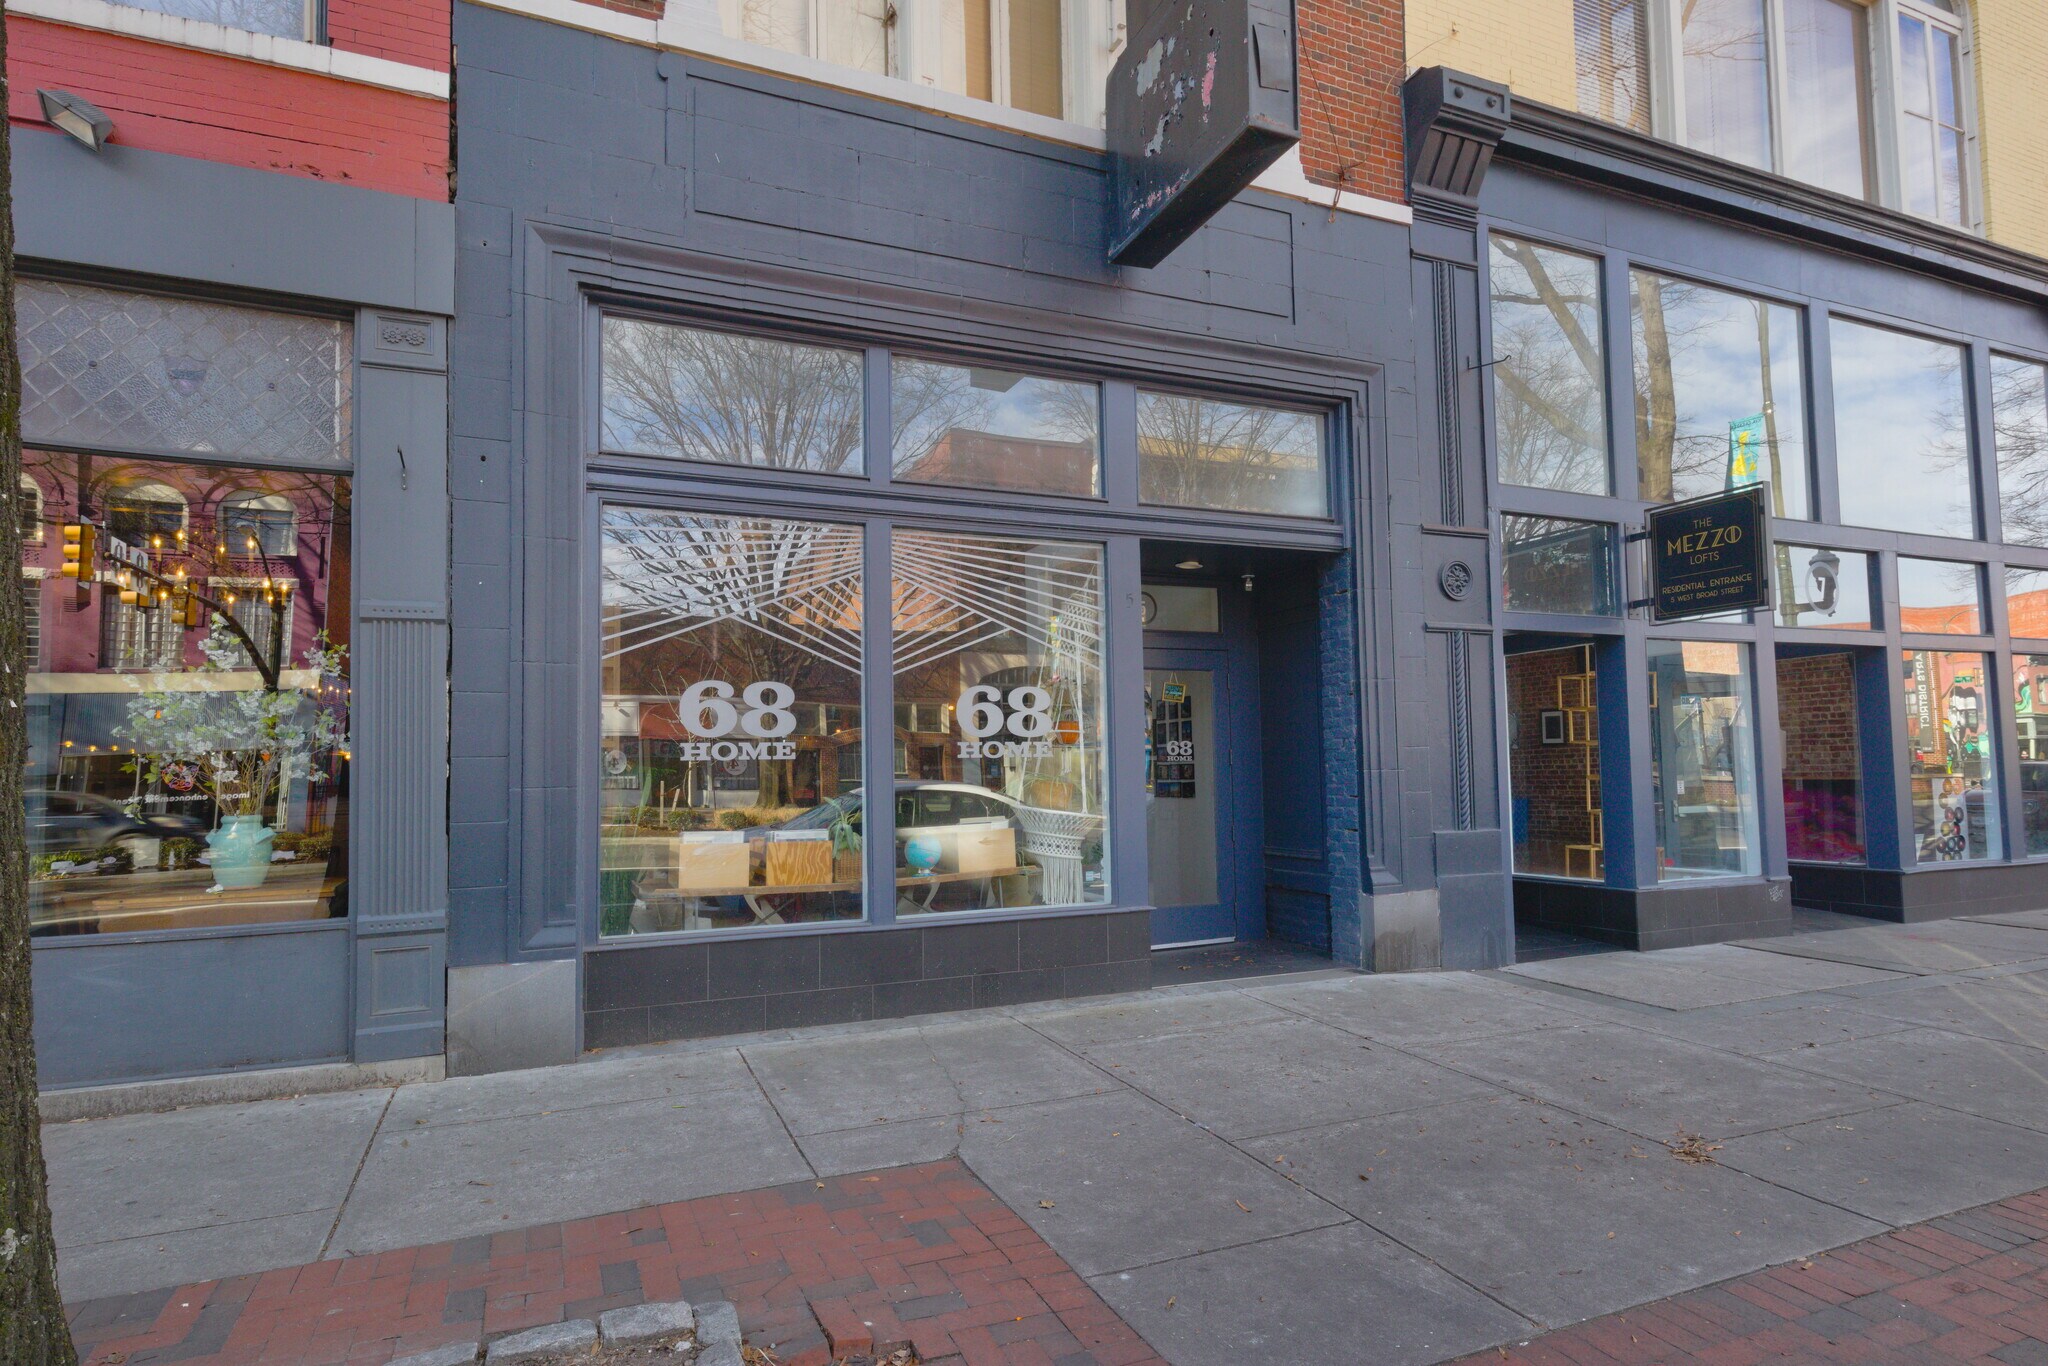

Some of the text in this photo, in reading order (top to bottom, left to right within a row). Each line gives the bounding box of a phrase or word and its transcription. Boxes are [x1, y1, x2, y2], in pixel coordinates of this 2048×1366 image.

[1693, 517, 1713, 529] THE
[1667, 525, 1742, 556] MEZZO
[1690, 551, 1720, 565] LOFTS
[1662, 573, 1753, 595] RESIDENTIAL ENTRANCE
[1677, 593, 1694, 602] WEST
[1696, 590, 1718, 600] BROAD
[1721, 586, 1744, 596] STREET
[679, 680, 797, 738] 68
[956, 685, 1053, 738] 68
[679, 741, 797, 761] HOME
[957, 741, 1053, 759] HOME
[1166, 740, 1193, 756] 68
